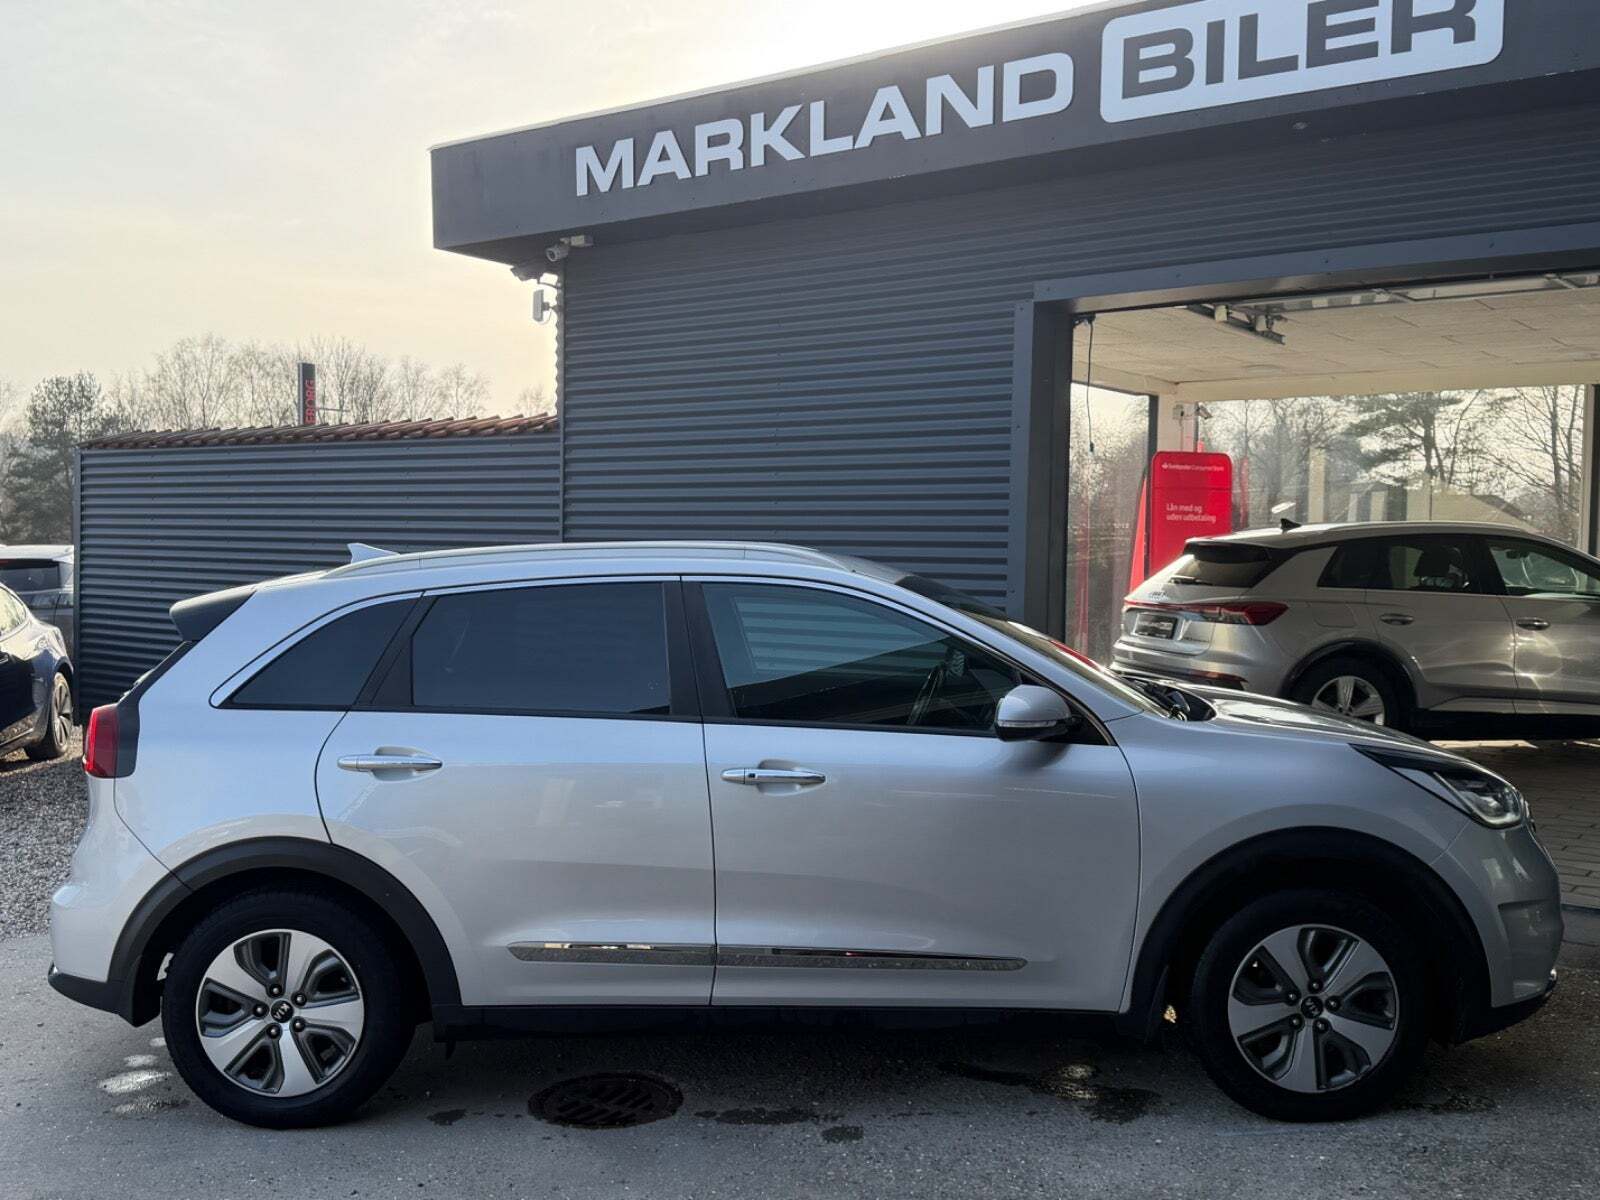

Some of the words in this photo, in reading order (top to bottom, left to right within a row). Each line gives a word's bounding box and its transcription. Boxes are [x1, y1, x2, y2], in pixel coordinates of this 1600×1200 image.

[575, 52, 1075, 197] MARKLAND
[1122, 0, 1476, 99] BILER
[1179, 503, 1193, 512] med
[1194, 505, 1203, 513] og
[273, 1003, 290, 1019] KIA
